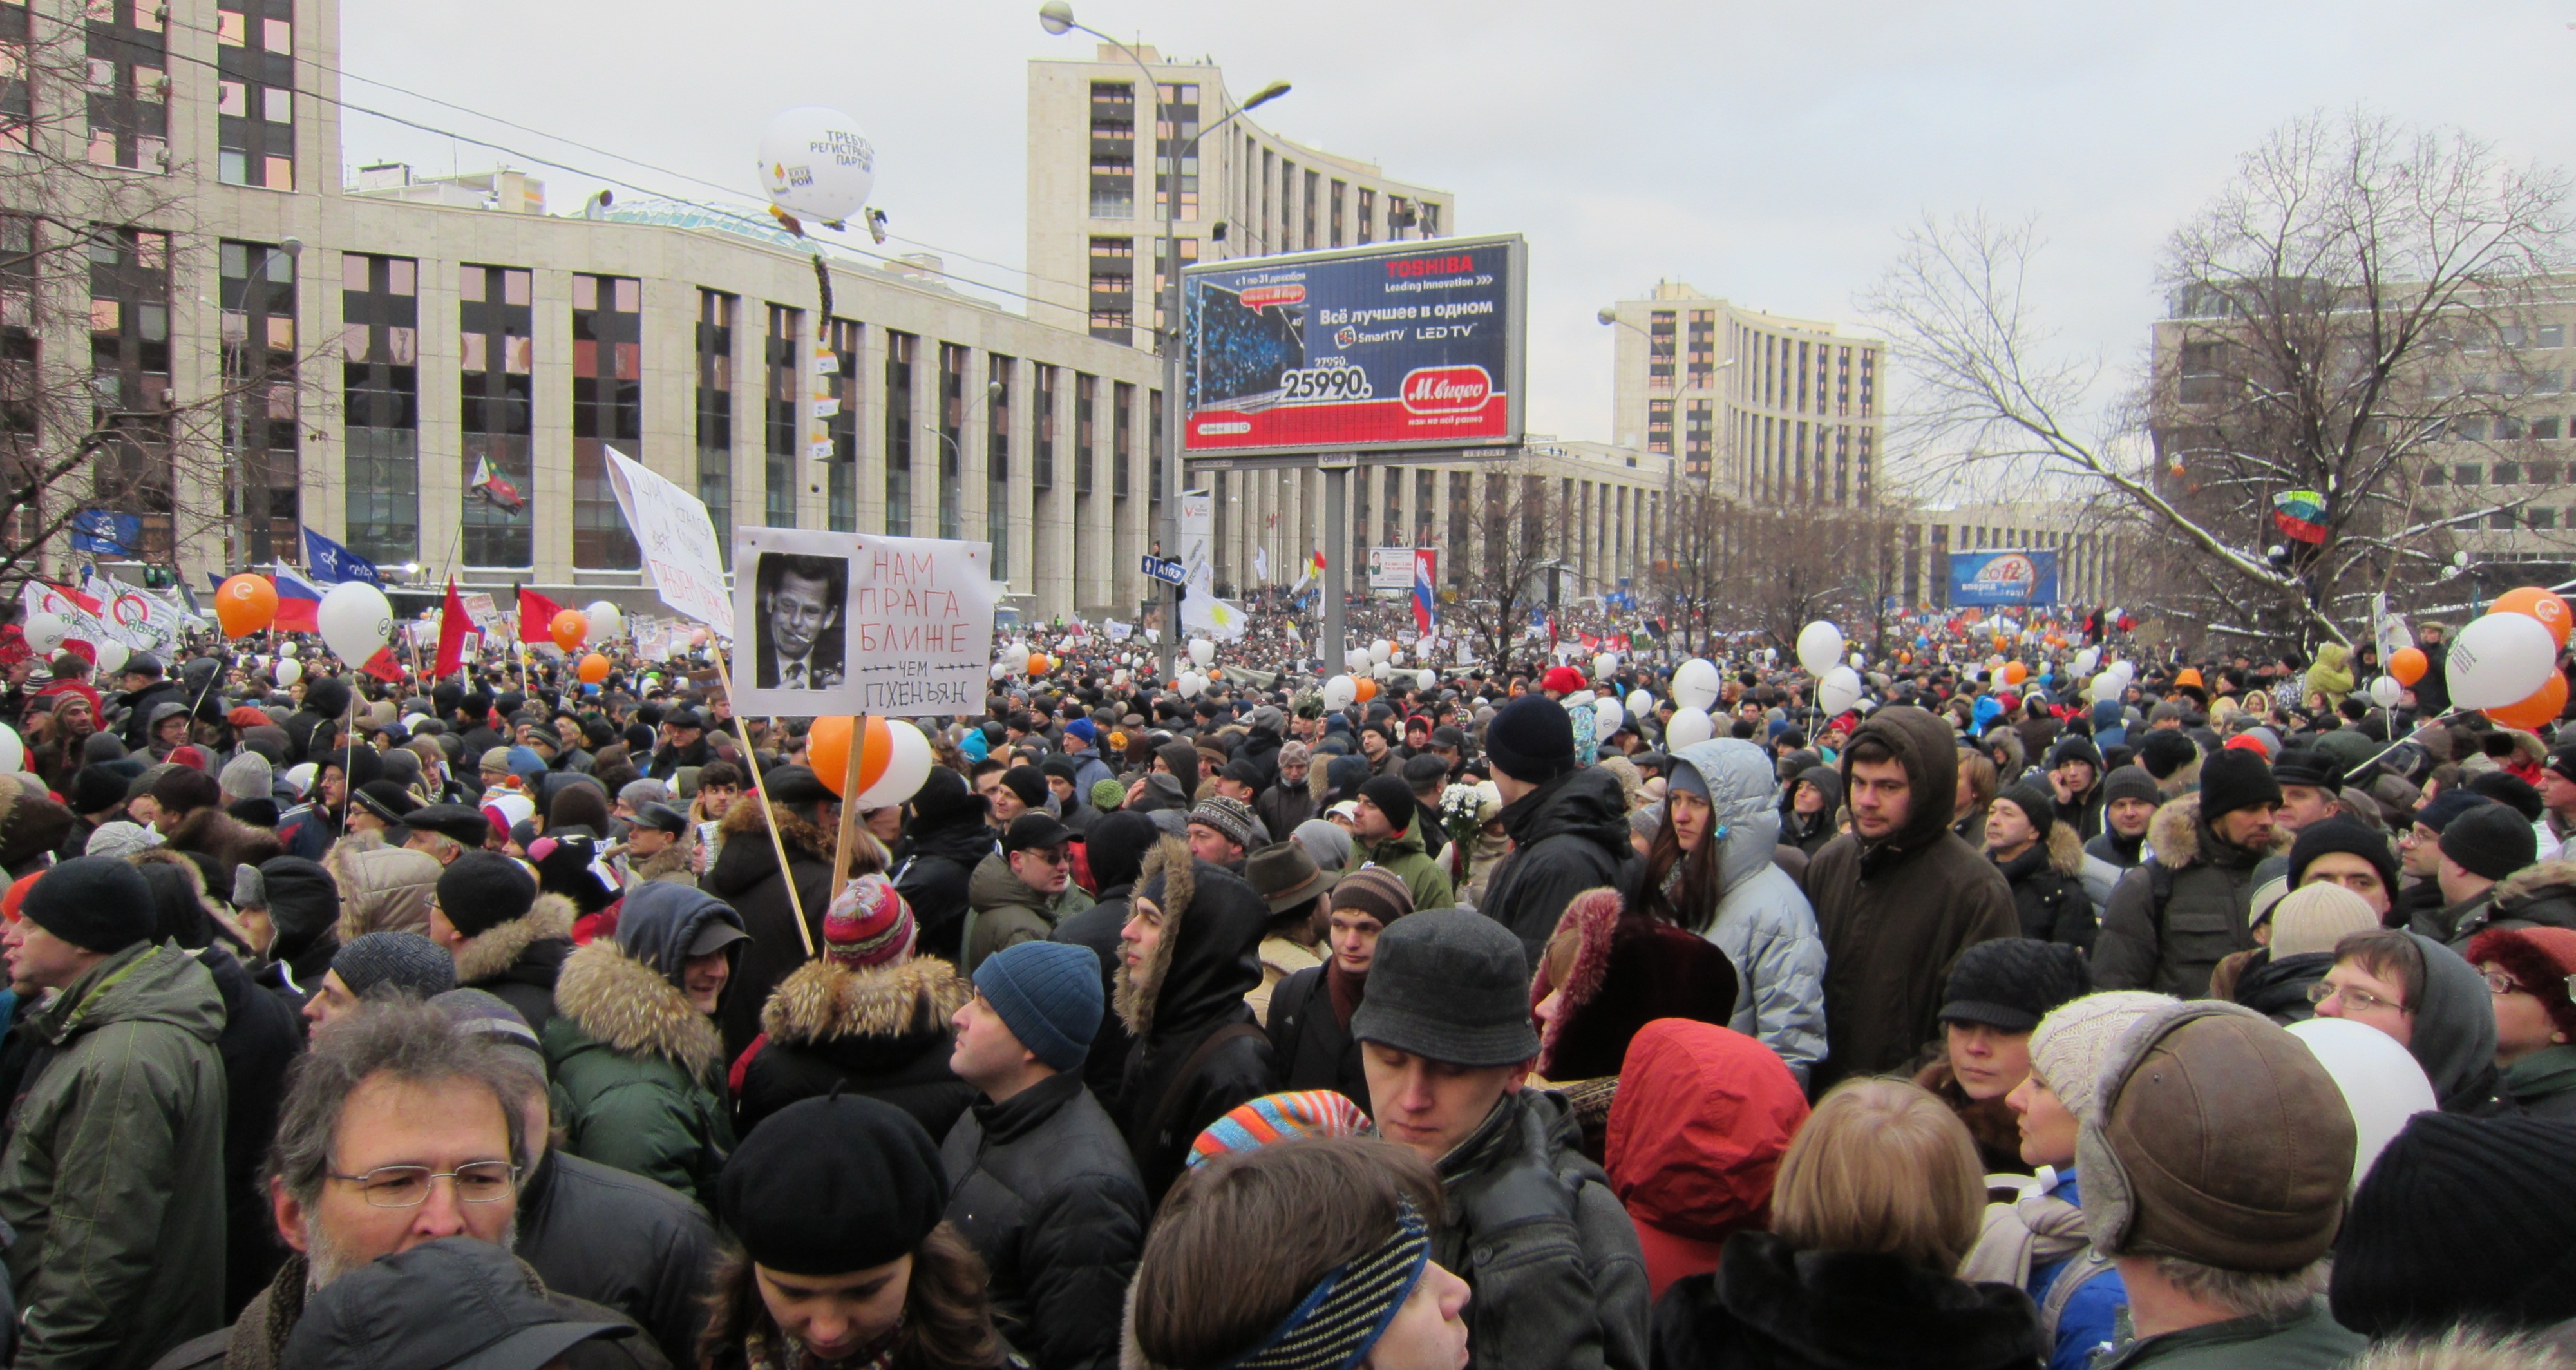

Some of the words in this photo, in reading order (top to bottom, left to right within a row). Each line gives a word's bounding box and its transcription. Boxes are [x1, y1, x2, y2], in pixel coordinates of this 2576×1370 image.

[791, 175, 813, 187] РОЙ
[1386, 255, 1473, 278] TOSHIBA
[1259, 274, 1268, 283] 31
[1385, 281, 1421, 293] Leading
[1423, 277, 1473, 289] Innovation
[1320, 307, 1347, 325] Всё
[1350, 305, 1417, 326] лучшее
[1421, 305, 1431, 318] в
[1434, 301, 1493, 319] одном
[1417, 326, 1448, 339] LED
[873, 551, 934, 587] НАМ
[860, 587, 960, 619] ПРАГА
[861, 623, 970, 652] БЛИЖЕ
[899, 660, 928, 678] ЧЕМ
[866, 681, 968, 709] ПХЕНЬЯН
